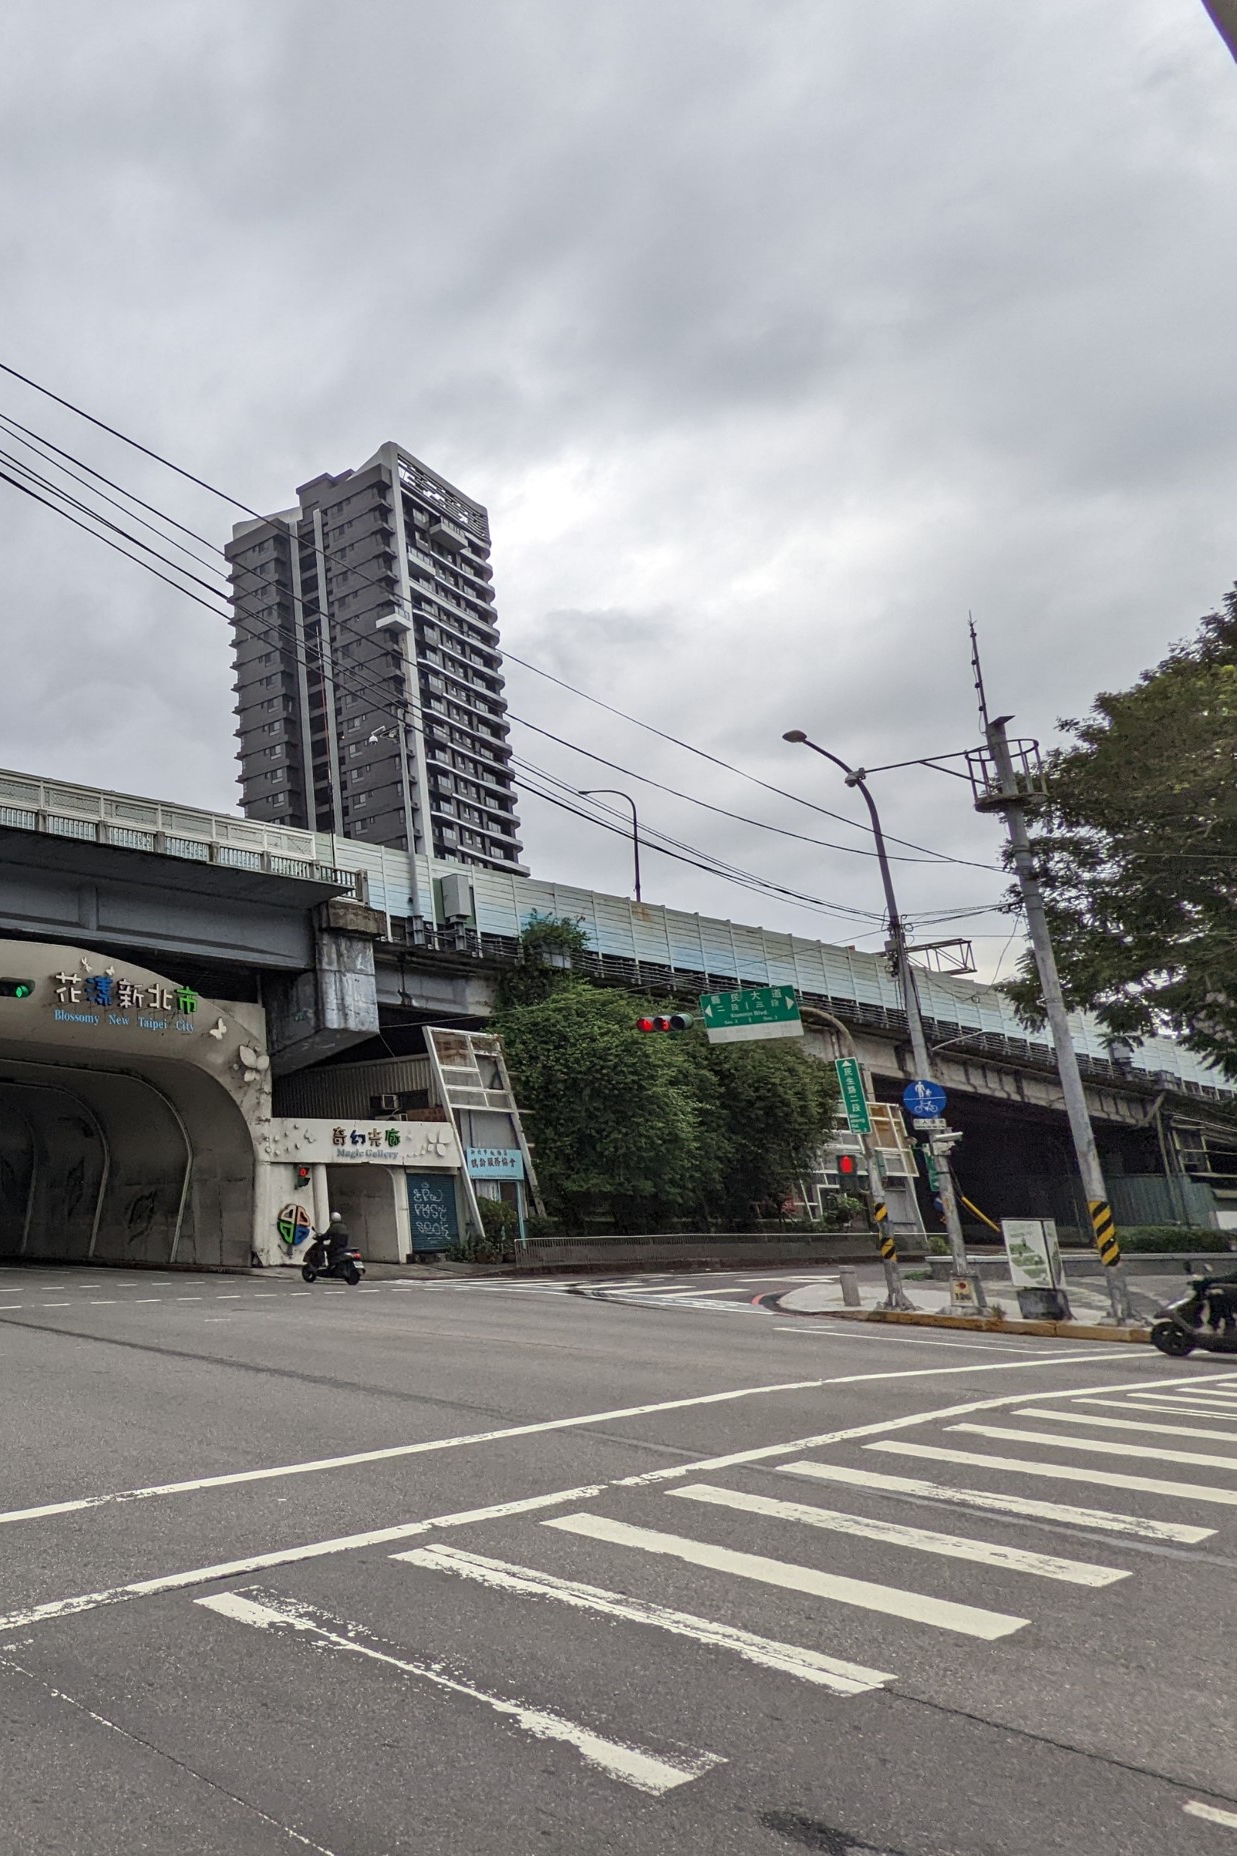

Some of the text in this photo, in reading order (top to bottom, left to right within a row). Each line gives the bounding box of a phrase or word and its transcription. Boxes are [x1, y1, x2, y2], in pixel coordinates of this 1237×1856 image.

[56, 972, 198, 1014] 花漾新北市
[54, 1010, 195, 1032] Blossomy New Taipei City
[332, 1126, 401, 1147] 奇幻光廊
[337, 1148, 398, 1159] Magic Gallery
